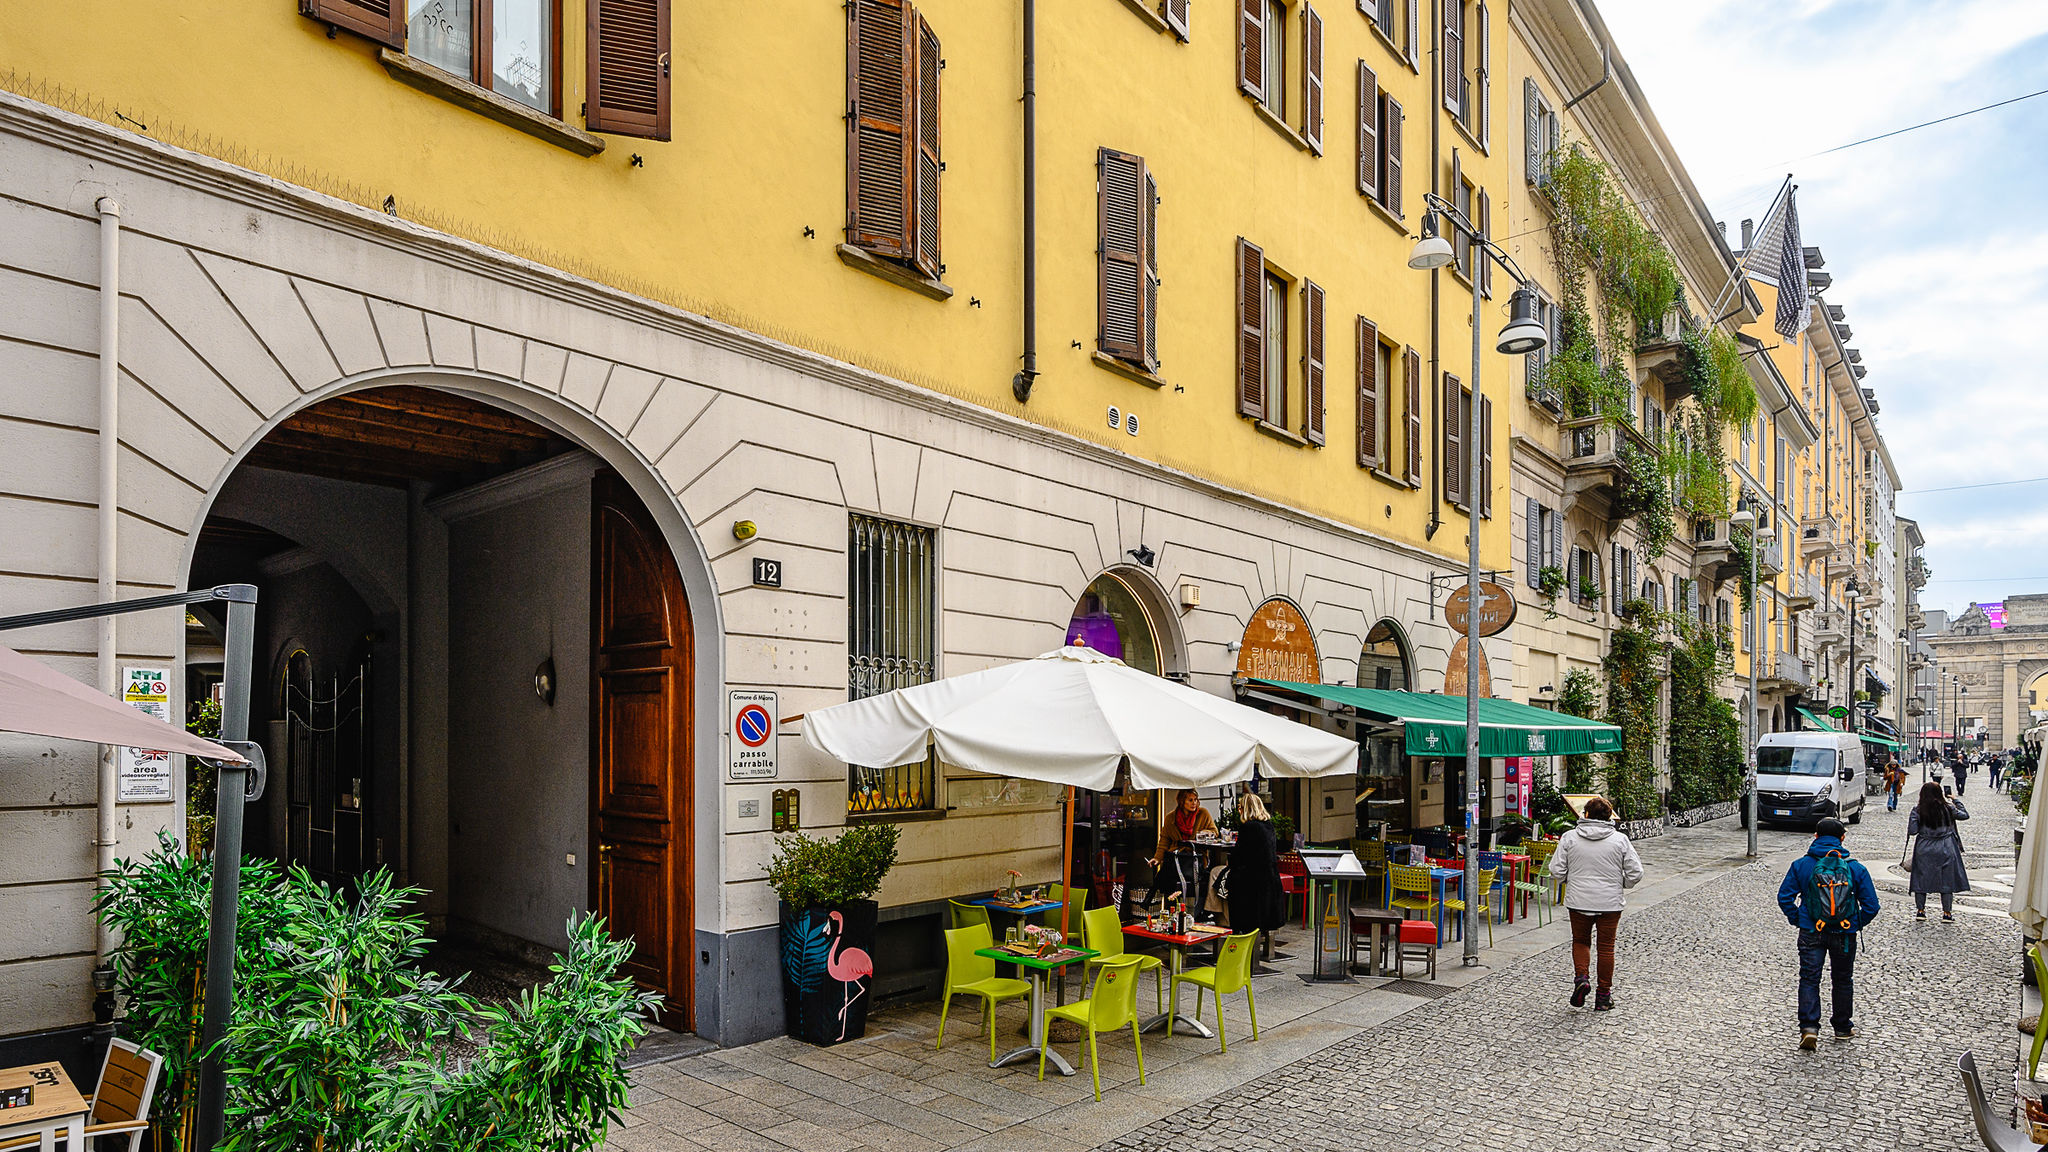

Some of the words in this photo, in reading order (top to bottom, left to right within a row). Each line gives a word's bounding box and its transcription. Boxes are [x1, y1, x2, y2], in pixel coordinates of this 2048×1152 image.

[759, 561, 777, 582] 12
[740, 751, 767, 759] passo
[733, 760, 774, 768] carrabile
